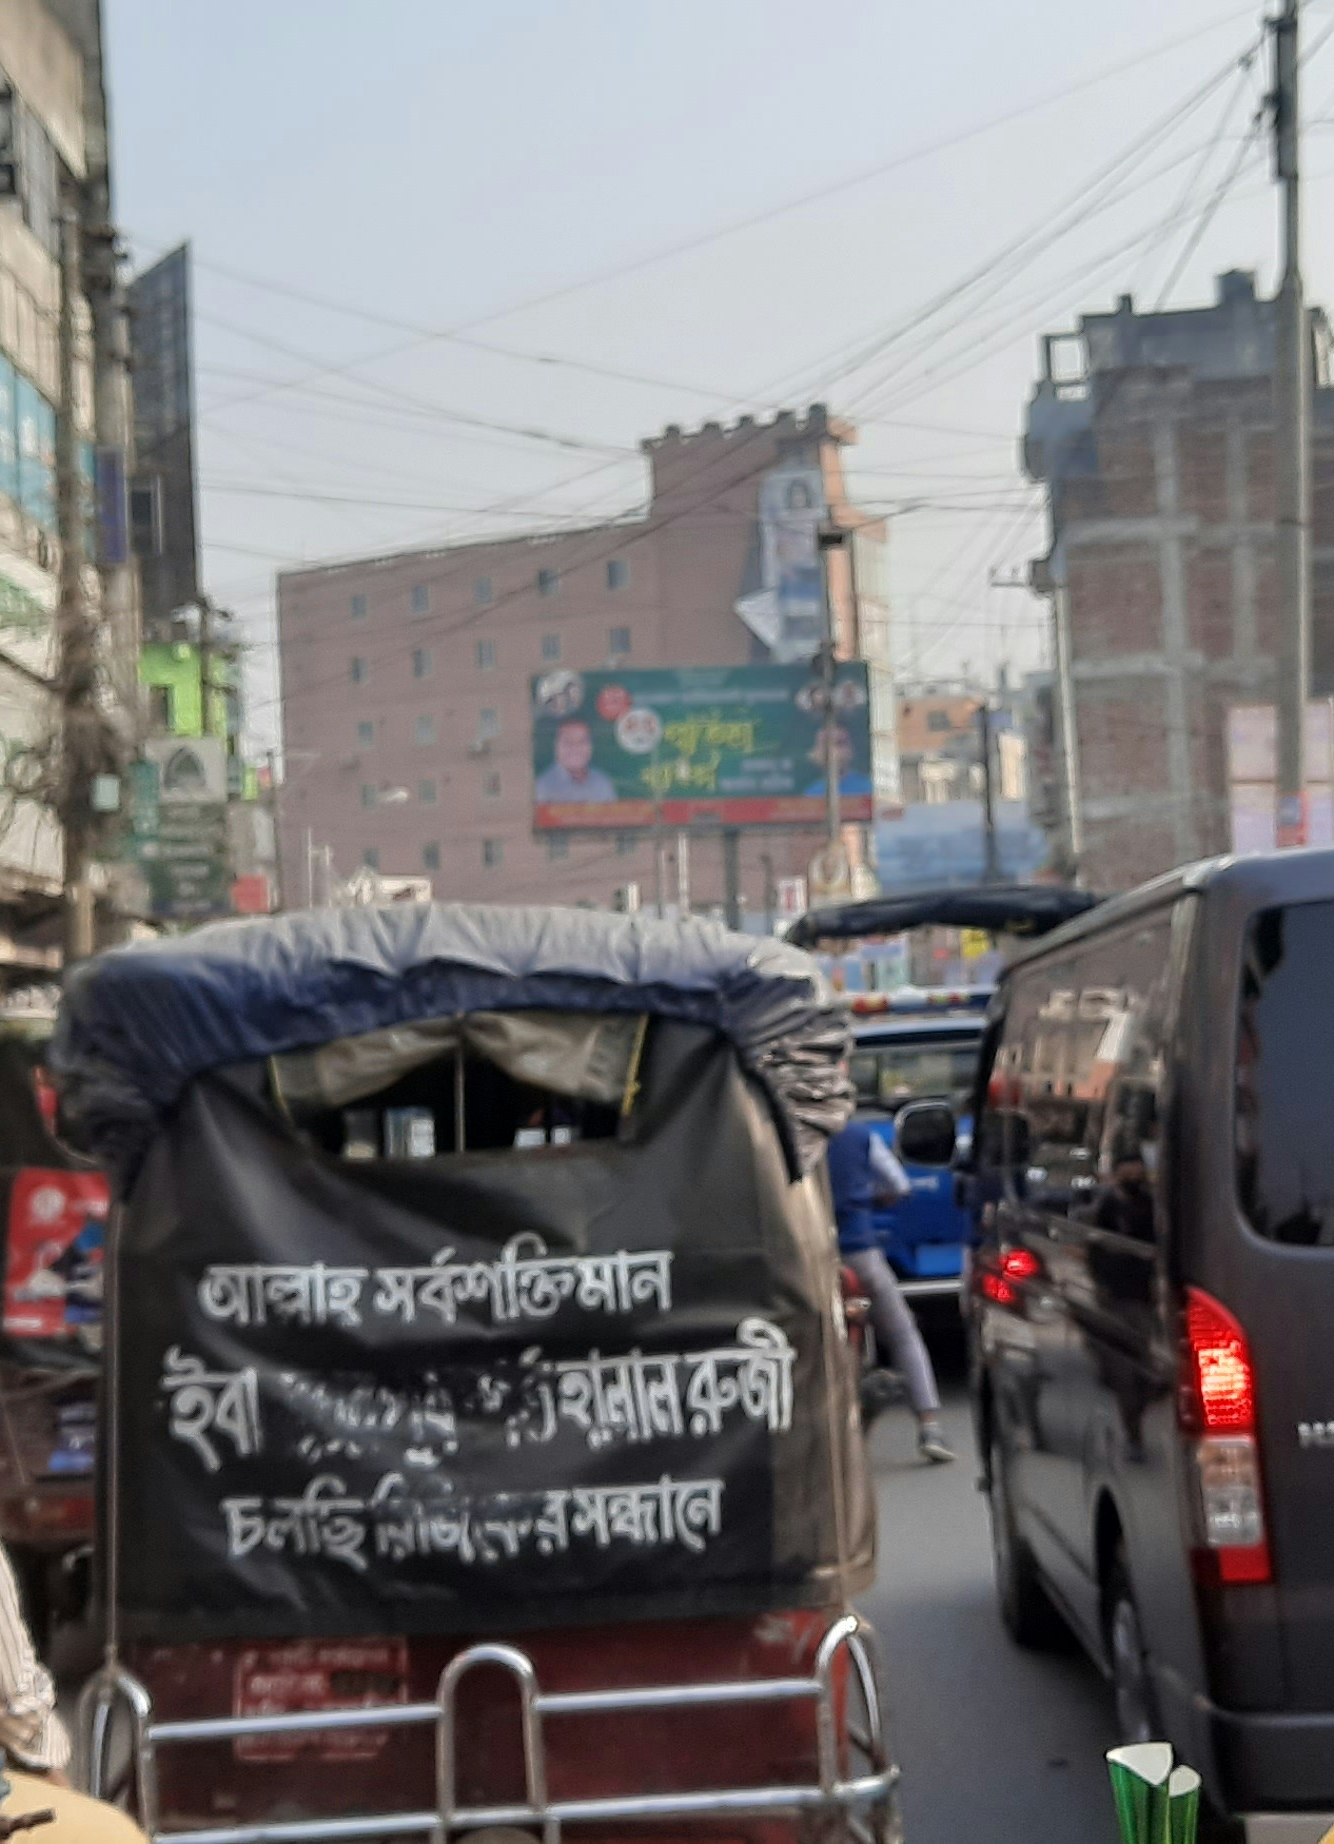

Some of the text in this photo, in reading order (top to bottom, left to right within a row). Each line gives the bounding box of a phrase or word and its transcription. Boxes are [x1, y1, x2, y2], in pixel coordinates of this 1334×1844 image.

[197, 1231, 674, 1326] আল্লাহ সর্বশক্তিমান
[220, 1472, 368, 1571] চলছি
[570, 1474, 726, 1552] সন্ধানে
